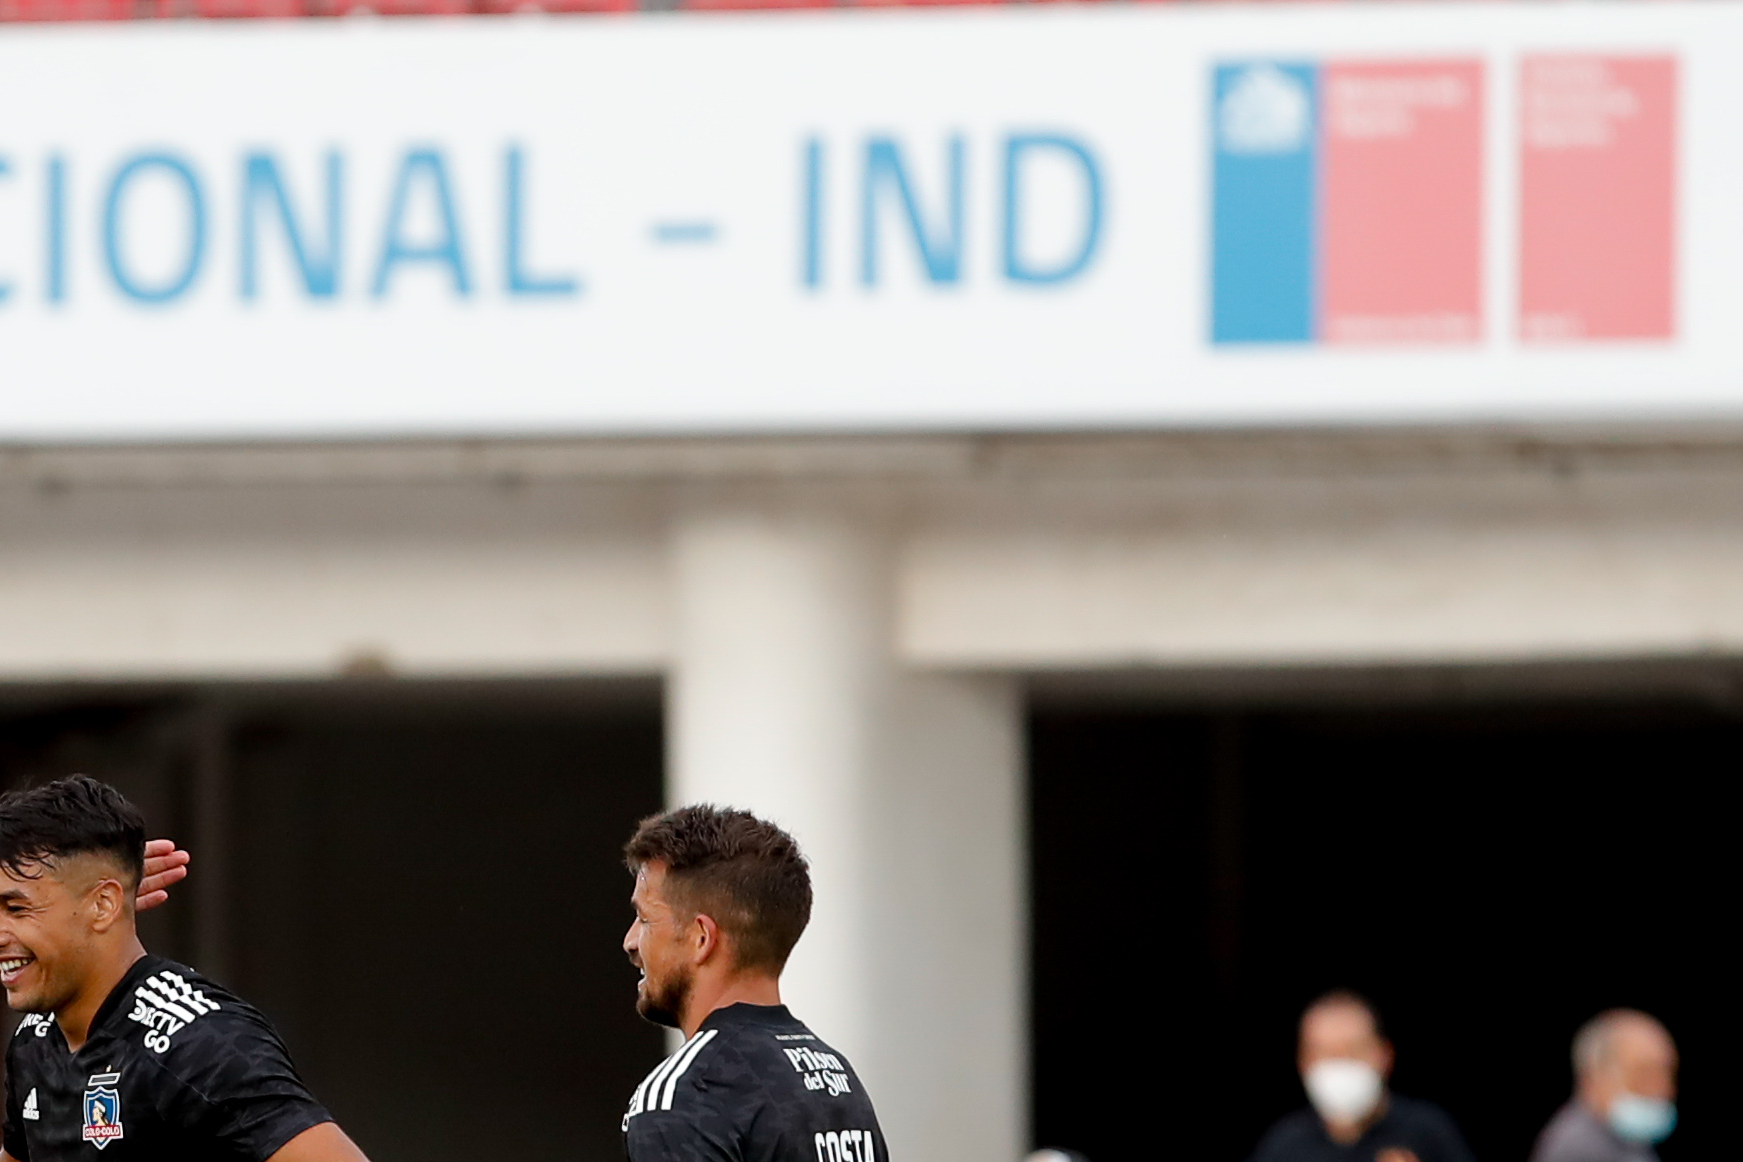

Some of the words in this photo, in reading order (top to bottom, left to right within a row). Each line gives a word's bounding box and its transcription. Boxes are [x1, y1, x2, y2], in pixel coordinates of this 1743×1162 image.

[801, 130, 1109, 292] IND
[143, 1029, 171, 1054] GO
[782, 1046, 845, 1072] Pilsen
[803, 1071, 825, 1091] del
[822, 1069, 852, 1097] Sur
